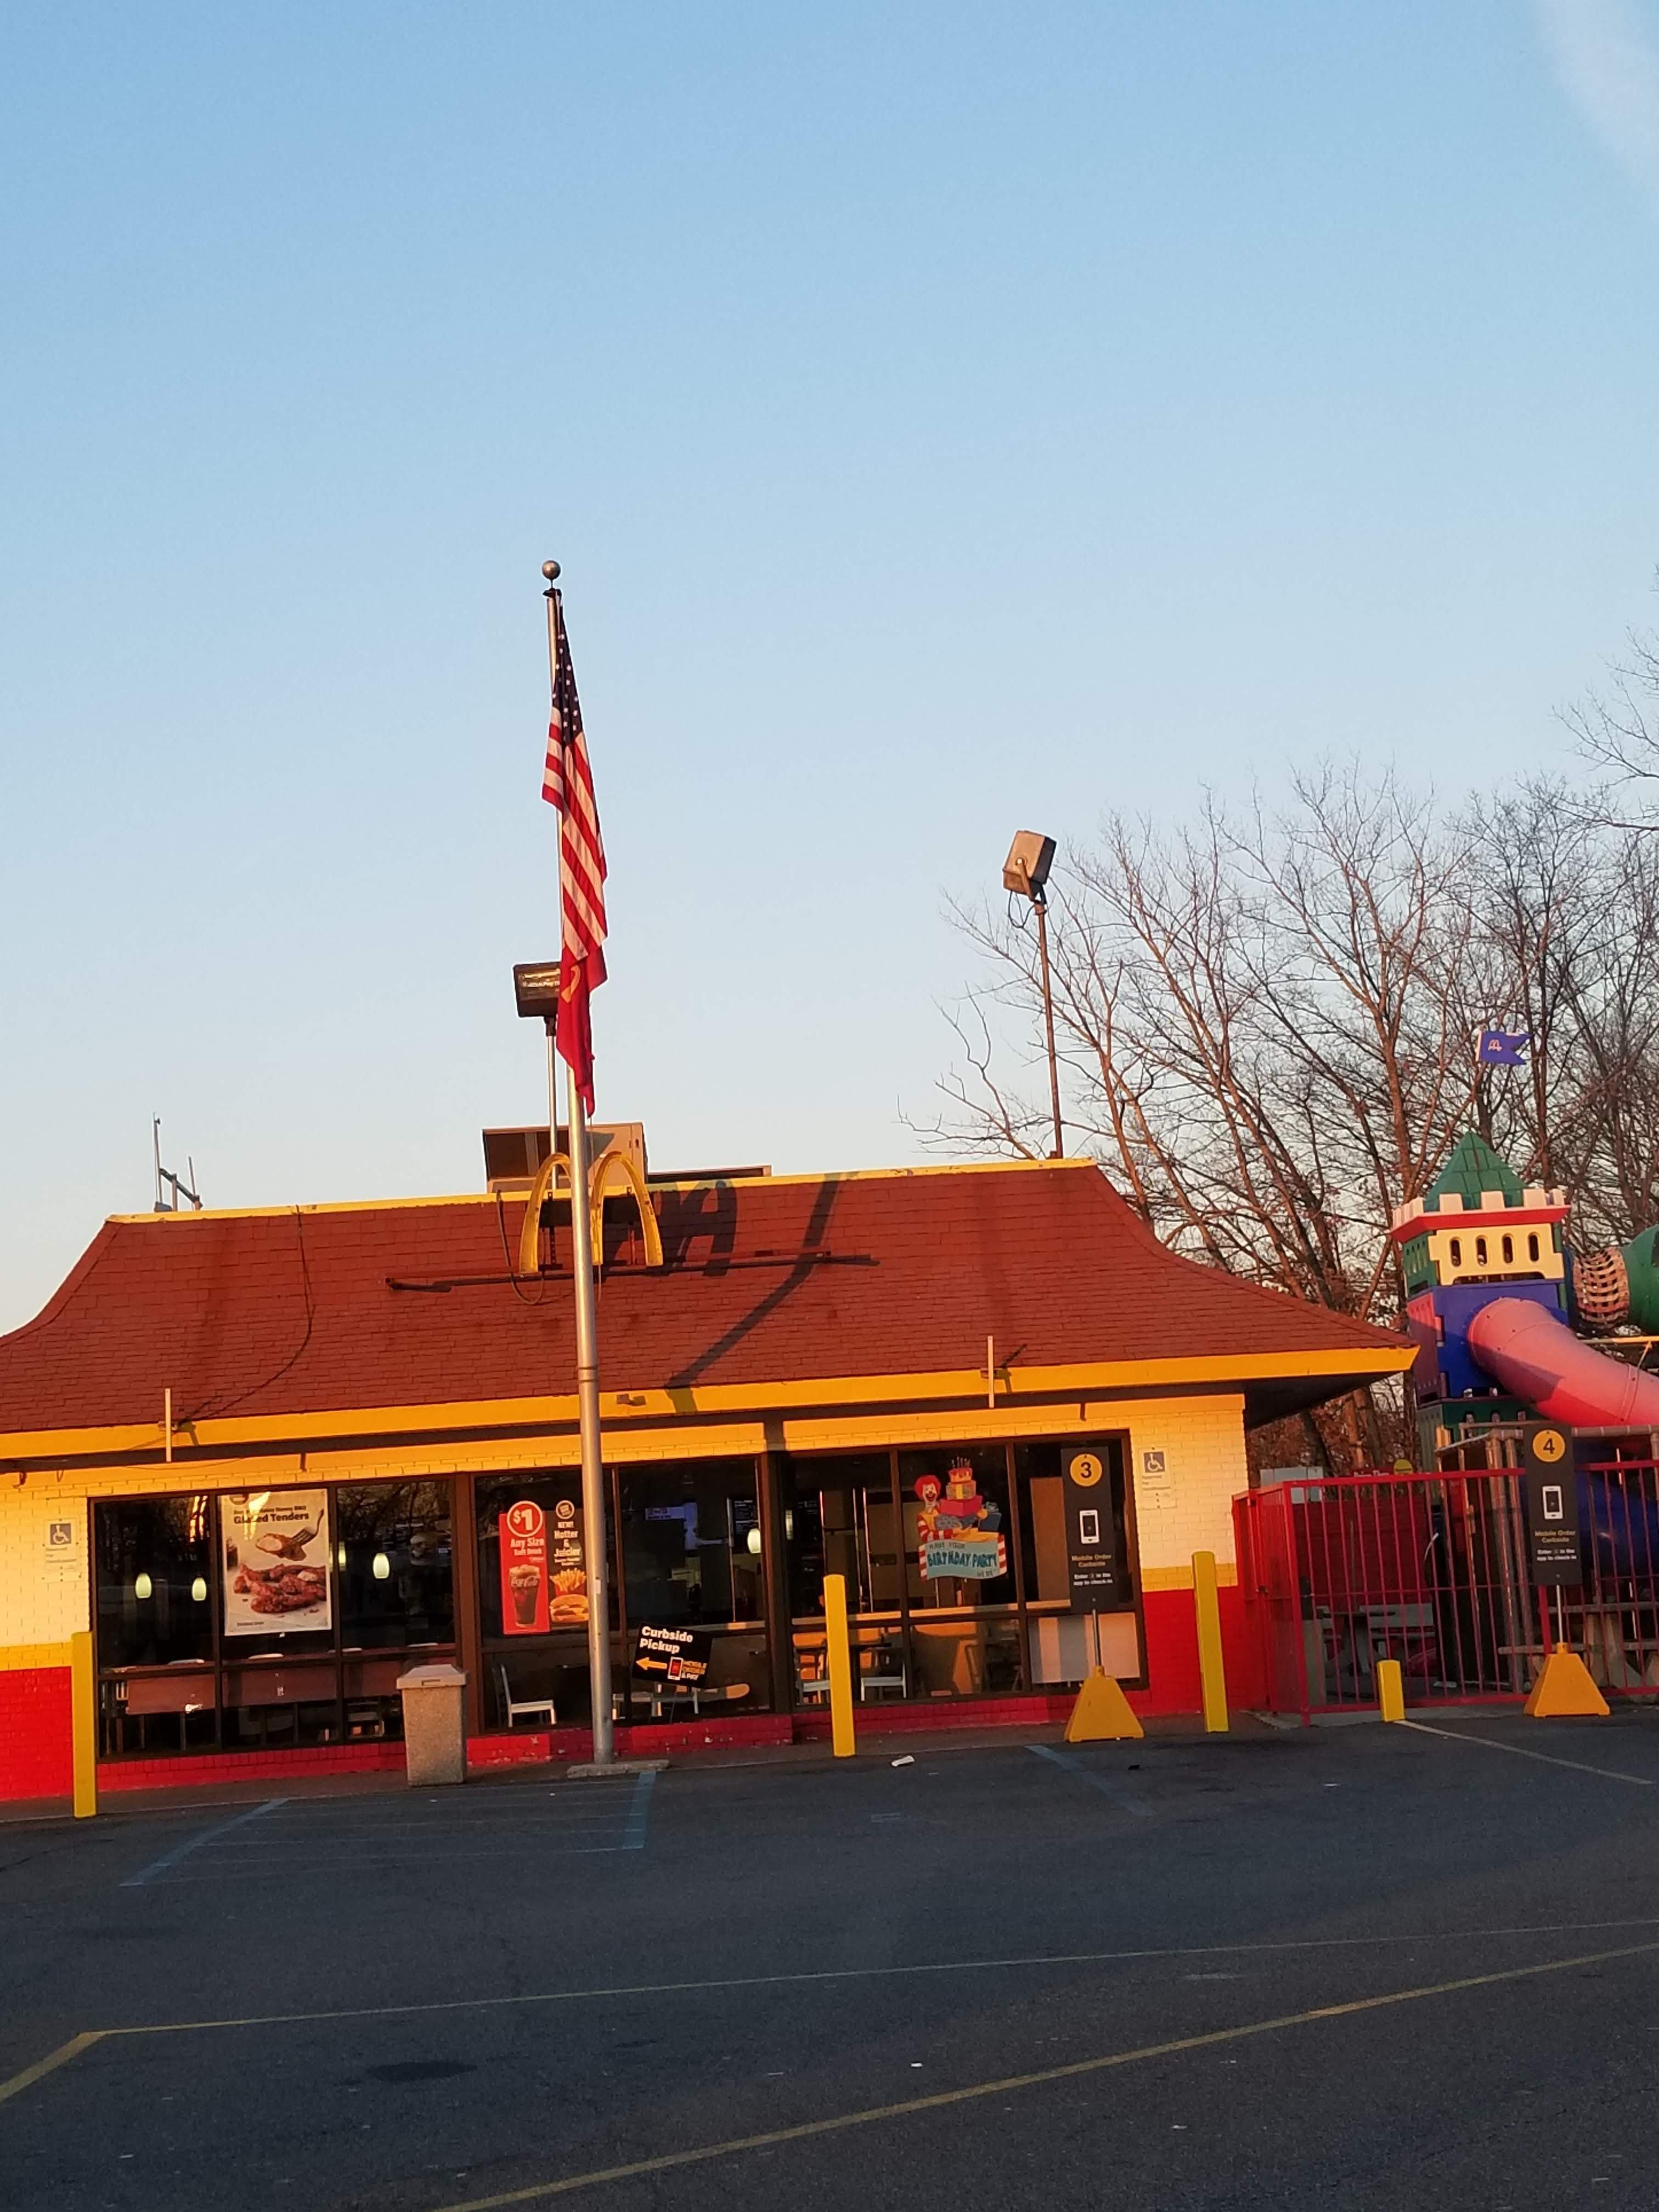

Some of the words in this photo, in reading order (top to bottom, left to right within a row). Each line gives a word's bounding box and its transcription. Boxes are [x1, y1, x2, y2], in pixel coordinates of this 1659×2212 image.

[1543, 1438, 1555, 1454] 4
[1080, 1462, 1092, 1479] 3
[270, 1513, 309, 1522] Tenders
[513, 1509, 533, 1531] $1
[527, 1537, 545, 1547] Size
[927, 1551, 971, 1567] BIRTHDAY
[972, 1553, 997, 1567] PARTY
[641, 1626, 693, 1643] Curbside
[639, 1638, 680, 1654] Pickup
